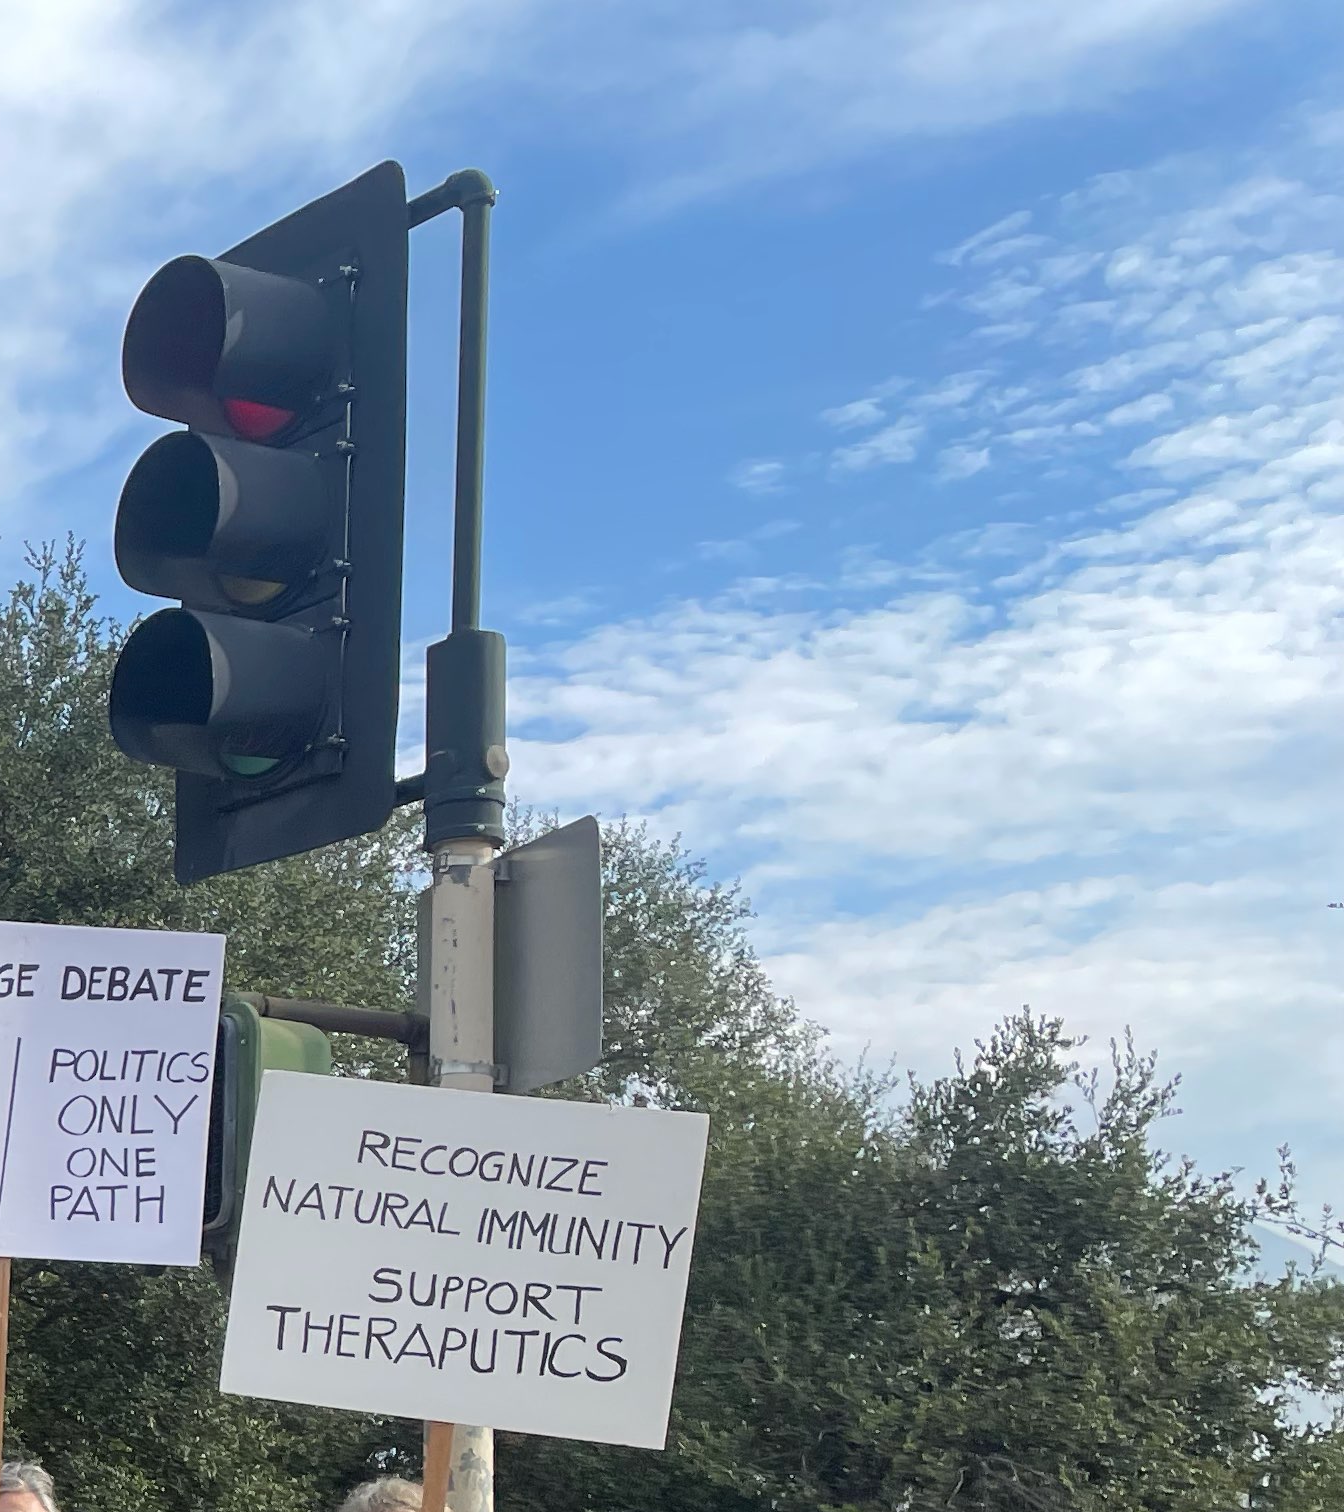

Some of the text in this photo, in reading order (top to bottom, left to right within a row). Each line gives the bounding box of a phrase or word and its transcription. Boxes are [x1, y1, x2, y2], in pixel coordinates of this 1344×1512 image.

[60, 965, 211, 1002] DEBATE
[49, 1048, 210, 1083] POLITICS
[57, 1094, 199, 1135] ONLY
[66, 1147, 156, 1178] ONE
[357, 1130, 609, 1197] RECOGNIZE
[50, 1184, 164, 1223] PATH
[262, 1175, 688, 1270] NATURAL IMMUNITY
[368, 1266, 603, 1325] SUPPORT
[266, 1304, 628, 1382] THERAPUTICS
